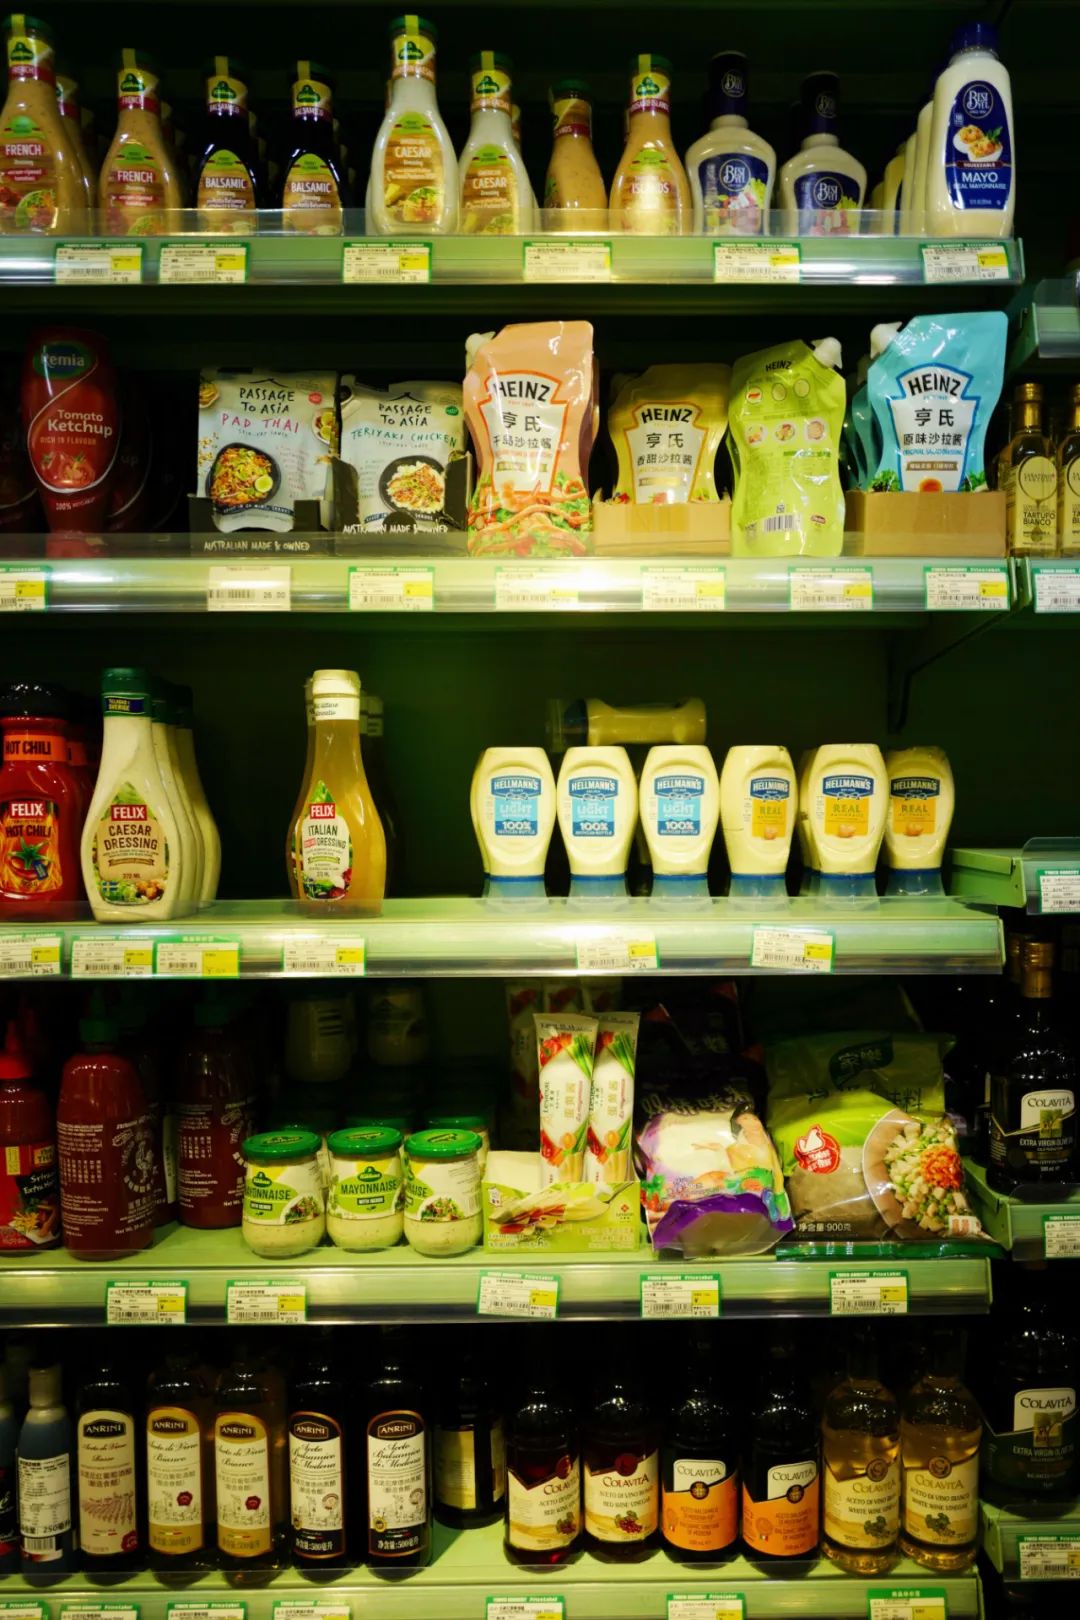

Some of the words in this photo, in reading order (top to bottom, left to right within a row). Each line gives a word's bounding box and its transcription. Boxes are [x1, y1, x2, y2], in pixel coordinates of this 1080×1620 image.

[5, 144, 42, 156] FRENCH
[395, 147, 432, 158] CAESAR
[117, 171, 153, 184] FRENCH
[205, 177, 247, 189] BALSAMIC
[473, 177, 507, 189] CAESAR
[962, 171, 998, 183] MAYO
[291, 182, 331, 193] BALSAMIC
[765, 360, 792, 372] HEINZ
[492, 381, 550, 401] HEINZ
[908, 374, 962, 397] HEINZ
[239, 387, 295, 402] PASSAGE
[378, 403, 432, 415] PASSAGE
[57, 410, 104, 422] Tomato
[641, 407, 694, 424] HEINZ
[914, 407, 955, 428] 亨氏
[48, 419, 113, 437] Ketchup
[221, 413, 251, 428] PAD
[262, 418, 299, 434] THAI
[351, 428, 404, 441] TERIYAKI
[410, 431, 456, 448] CHICKEN
[903, 432, 963, 447] 原味沙拉酱
[637, 453, 693, 466] 香甜沙拉酱
[1023, 512, 1056, 520] TARTUFO
[1023, 518, 1051, 527] BIANCO
[204, 541, 248, 551] AUSTRALIAN
[251, 541, 272, 550] MADE
[282, 542, 310, 551] OWNED
[494, 779, 539, 790] HELLMANN'S
[571, 780, 616, 791] HELLMANN'S
[657, 779, 702, 790] HELLMANN'S
[753, 781, 789, 792] HELLMANN'S
[825, 779, 871, 790] HELLMANN'S
[893, 780, 938, 791] HELLMANN'S
[11, 804, 43, 816] FELIX
[113, 806, 145, 819] FELIX
[311, 805, 334, 817] FELIX
[760, 806, 782, 815] REAL
[833, 804, 861, 813] REAL
[901, 804, 929, 813] REAL
[5, 825, 23, 838] HOT
[108, 824, 152, 836] CAESAR
[308, 825, 338, 836] ITALIAN
[503, 821, 531, 830] 100%
[580, 822, 608, 831] 100%
[665, 821, 693, 830] 100%
[104, 837, 158, 851] DRESSING
[317, 837, 347, 849] DRESSING
[1027, 1096, 1073, 1109] COLAVITA
[340, 1181, 398, 1195] MAYONNAISE
[1020, 1397, 1073, 1409] COLAVITA
[86, 1424, 122, 1433] ANRINI
[154, 1422, 185, 1430] ANRINI
[296, 1425, 326, 1435] ANRINI
[381, 1425, 413, 1434] ANRINI
[677, 1465, 721, 1477] COLAVITA
[772, 1468, 814, 1481] COLAVITA
[602, 1473, 649, 1489] COLAVITA
[852, 1480, 897, 1494] COLAVITA
[915, 1475, 964, 1489] COLAVITA
